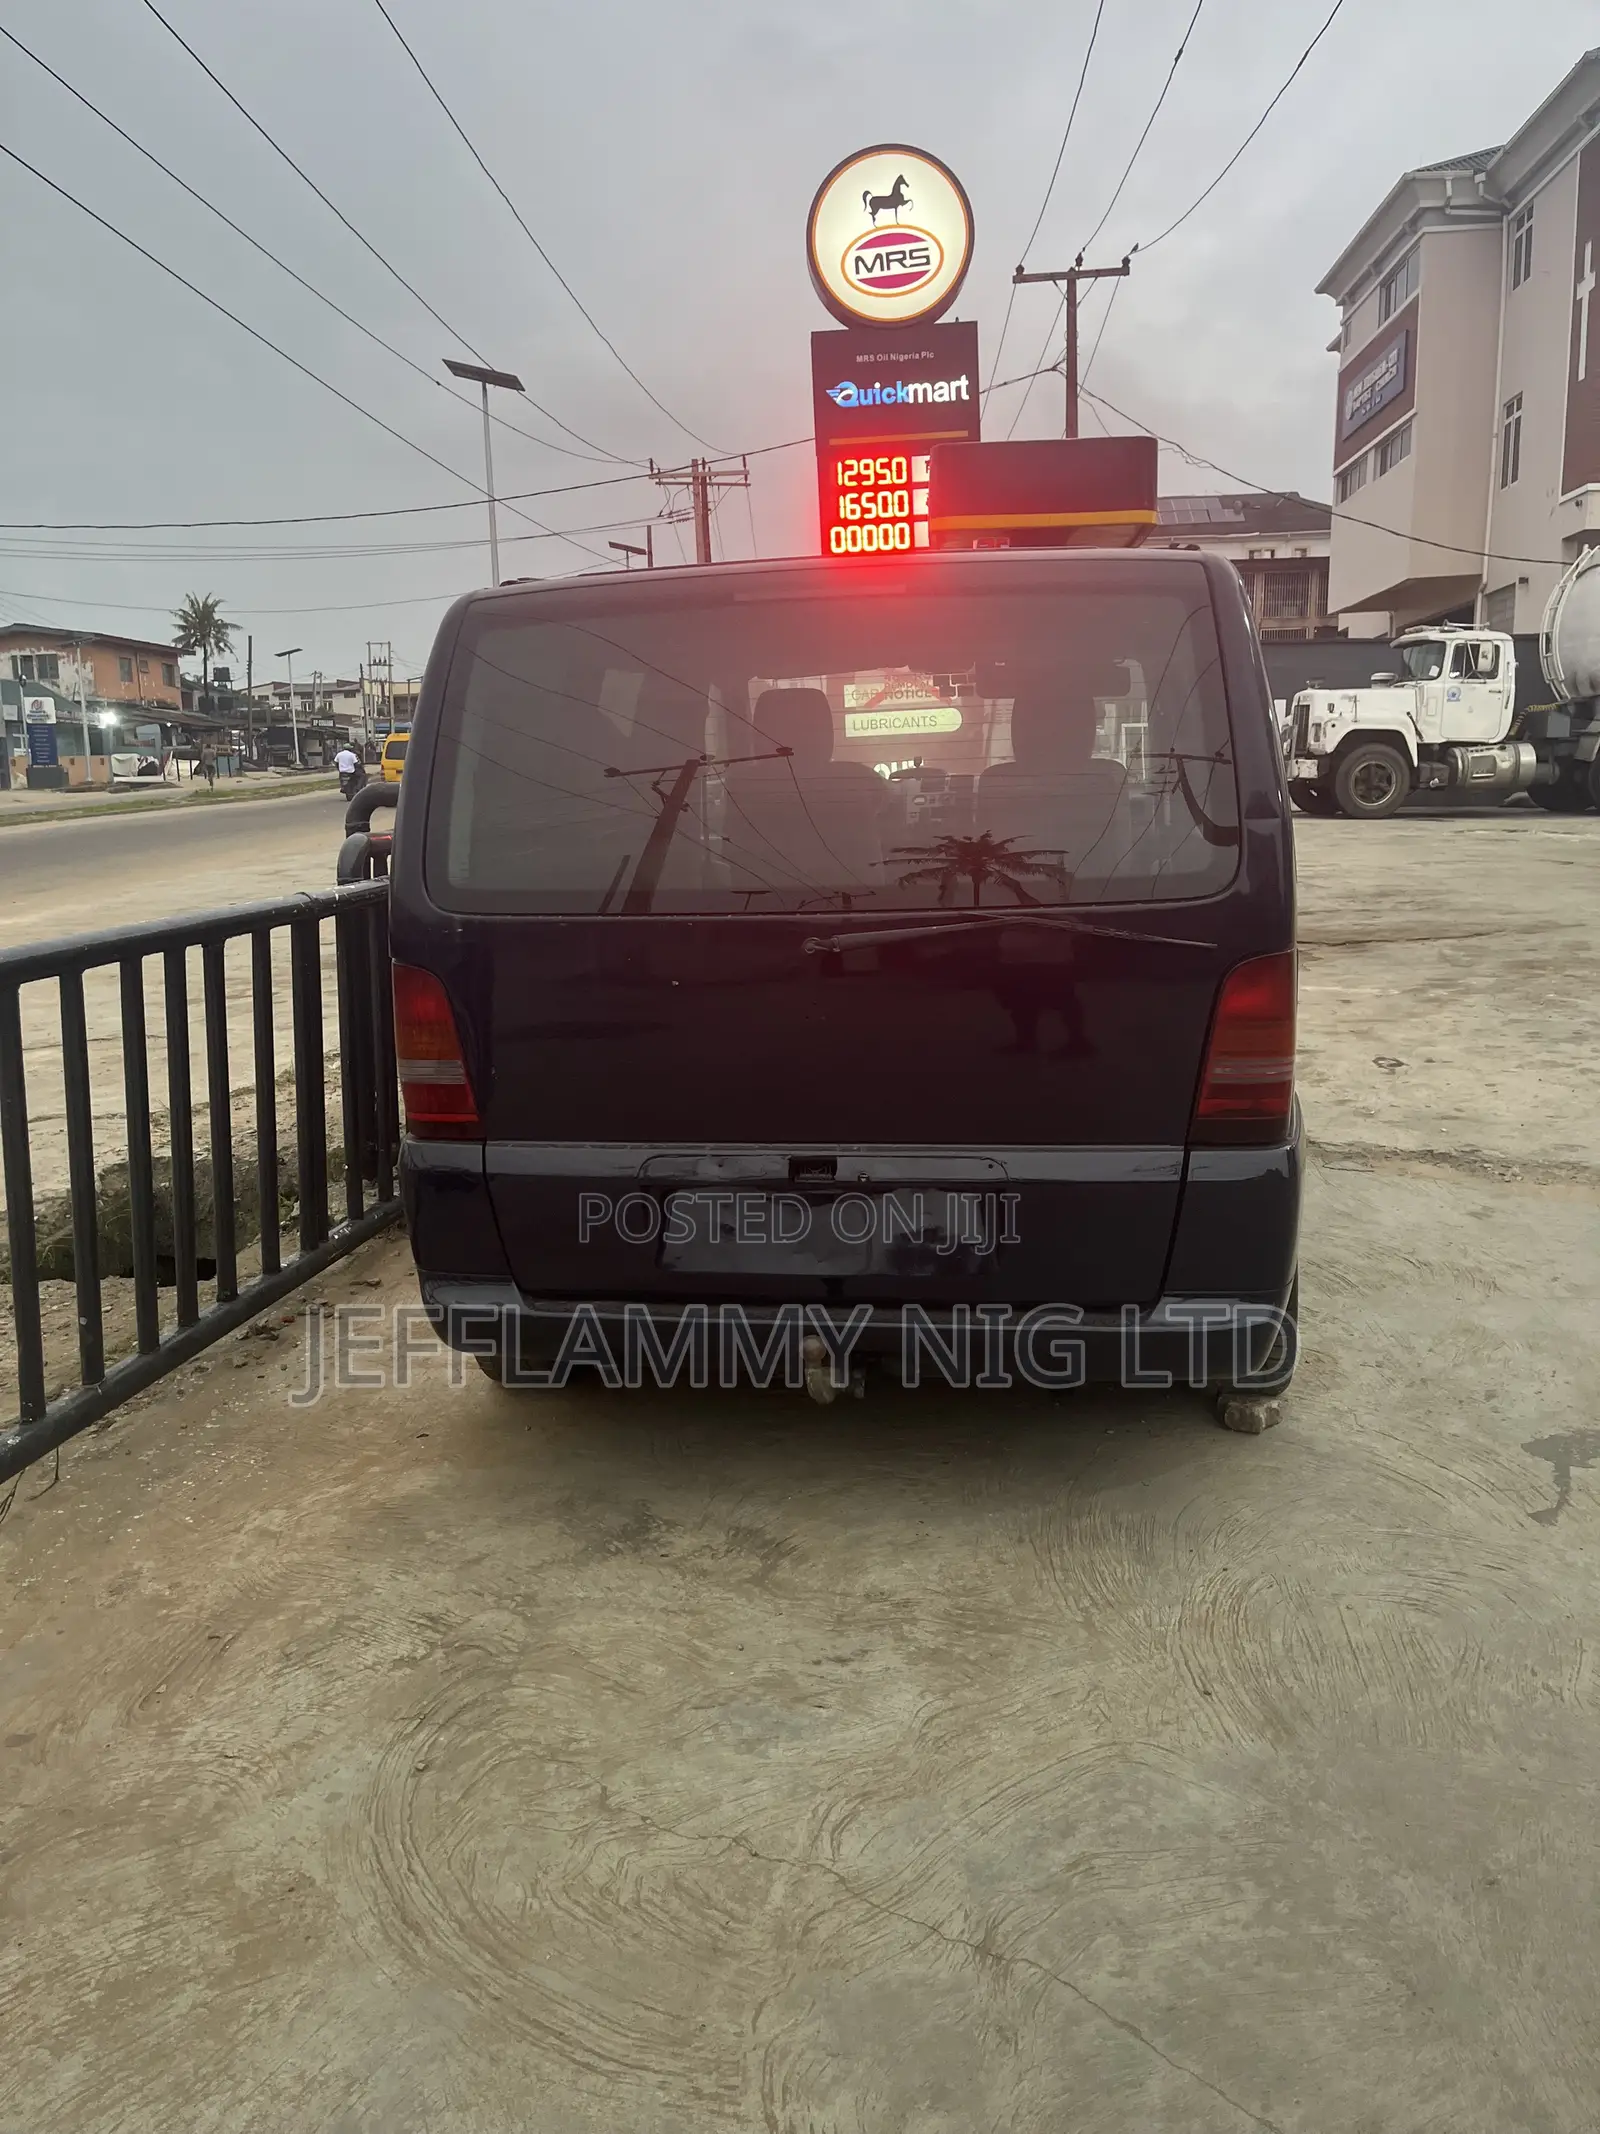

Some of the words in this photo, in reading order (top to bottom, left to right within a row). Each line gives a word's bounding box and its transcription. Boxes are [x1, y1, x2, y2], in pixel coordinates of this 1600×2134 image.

[855, 247, 931, 275] MRS
[856, 354, 875, 363] MRS
[877, 353, 889, 362] Oil
[890, 351, 920, 362] Nigeria
[921, 351, 934, 360] Plc
[826, 374, 970, 408] Quickmart
[830, 522, 910, 553] 00000
[853, 715, 938, 731] LUBRICANTS
